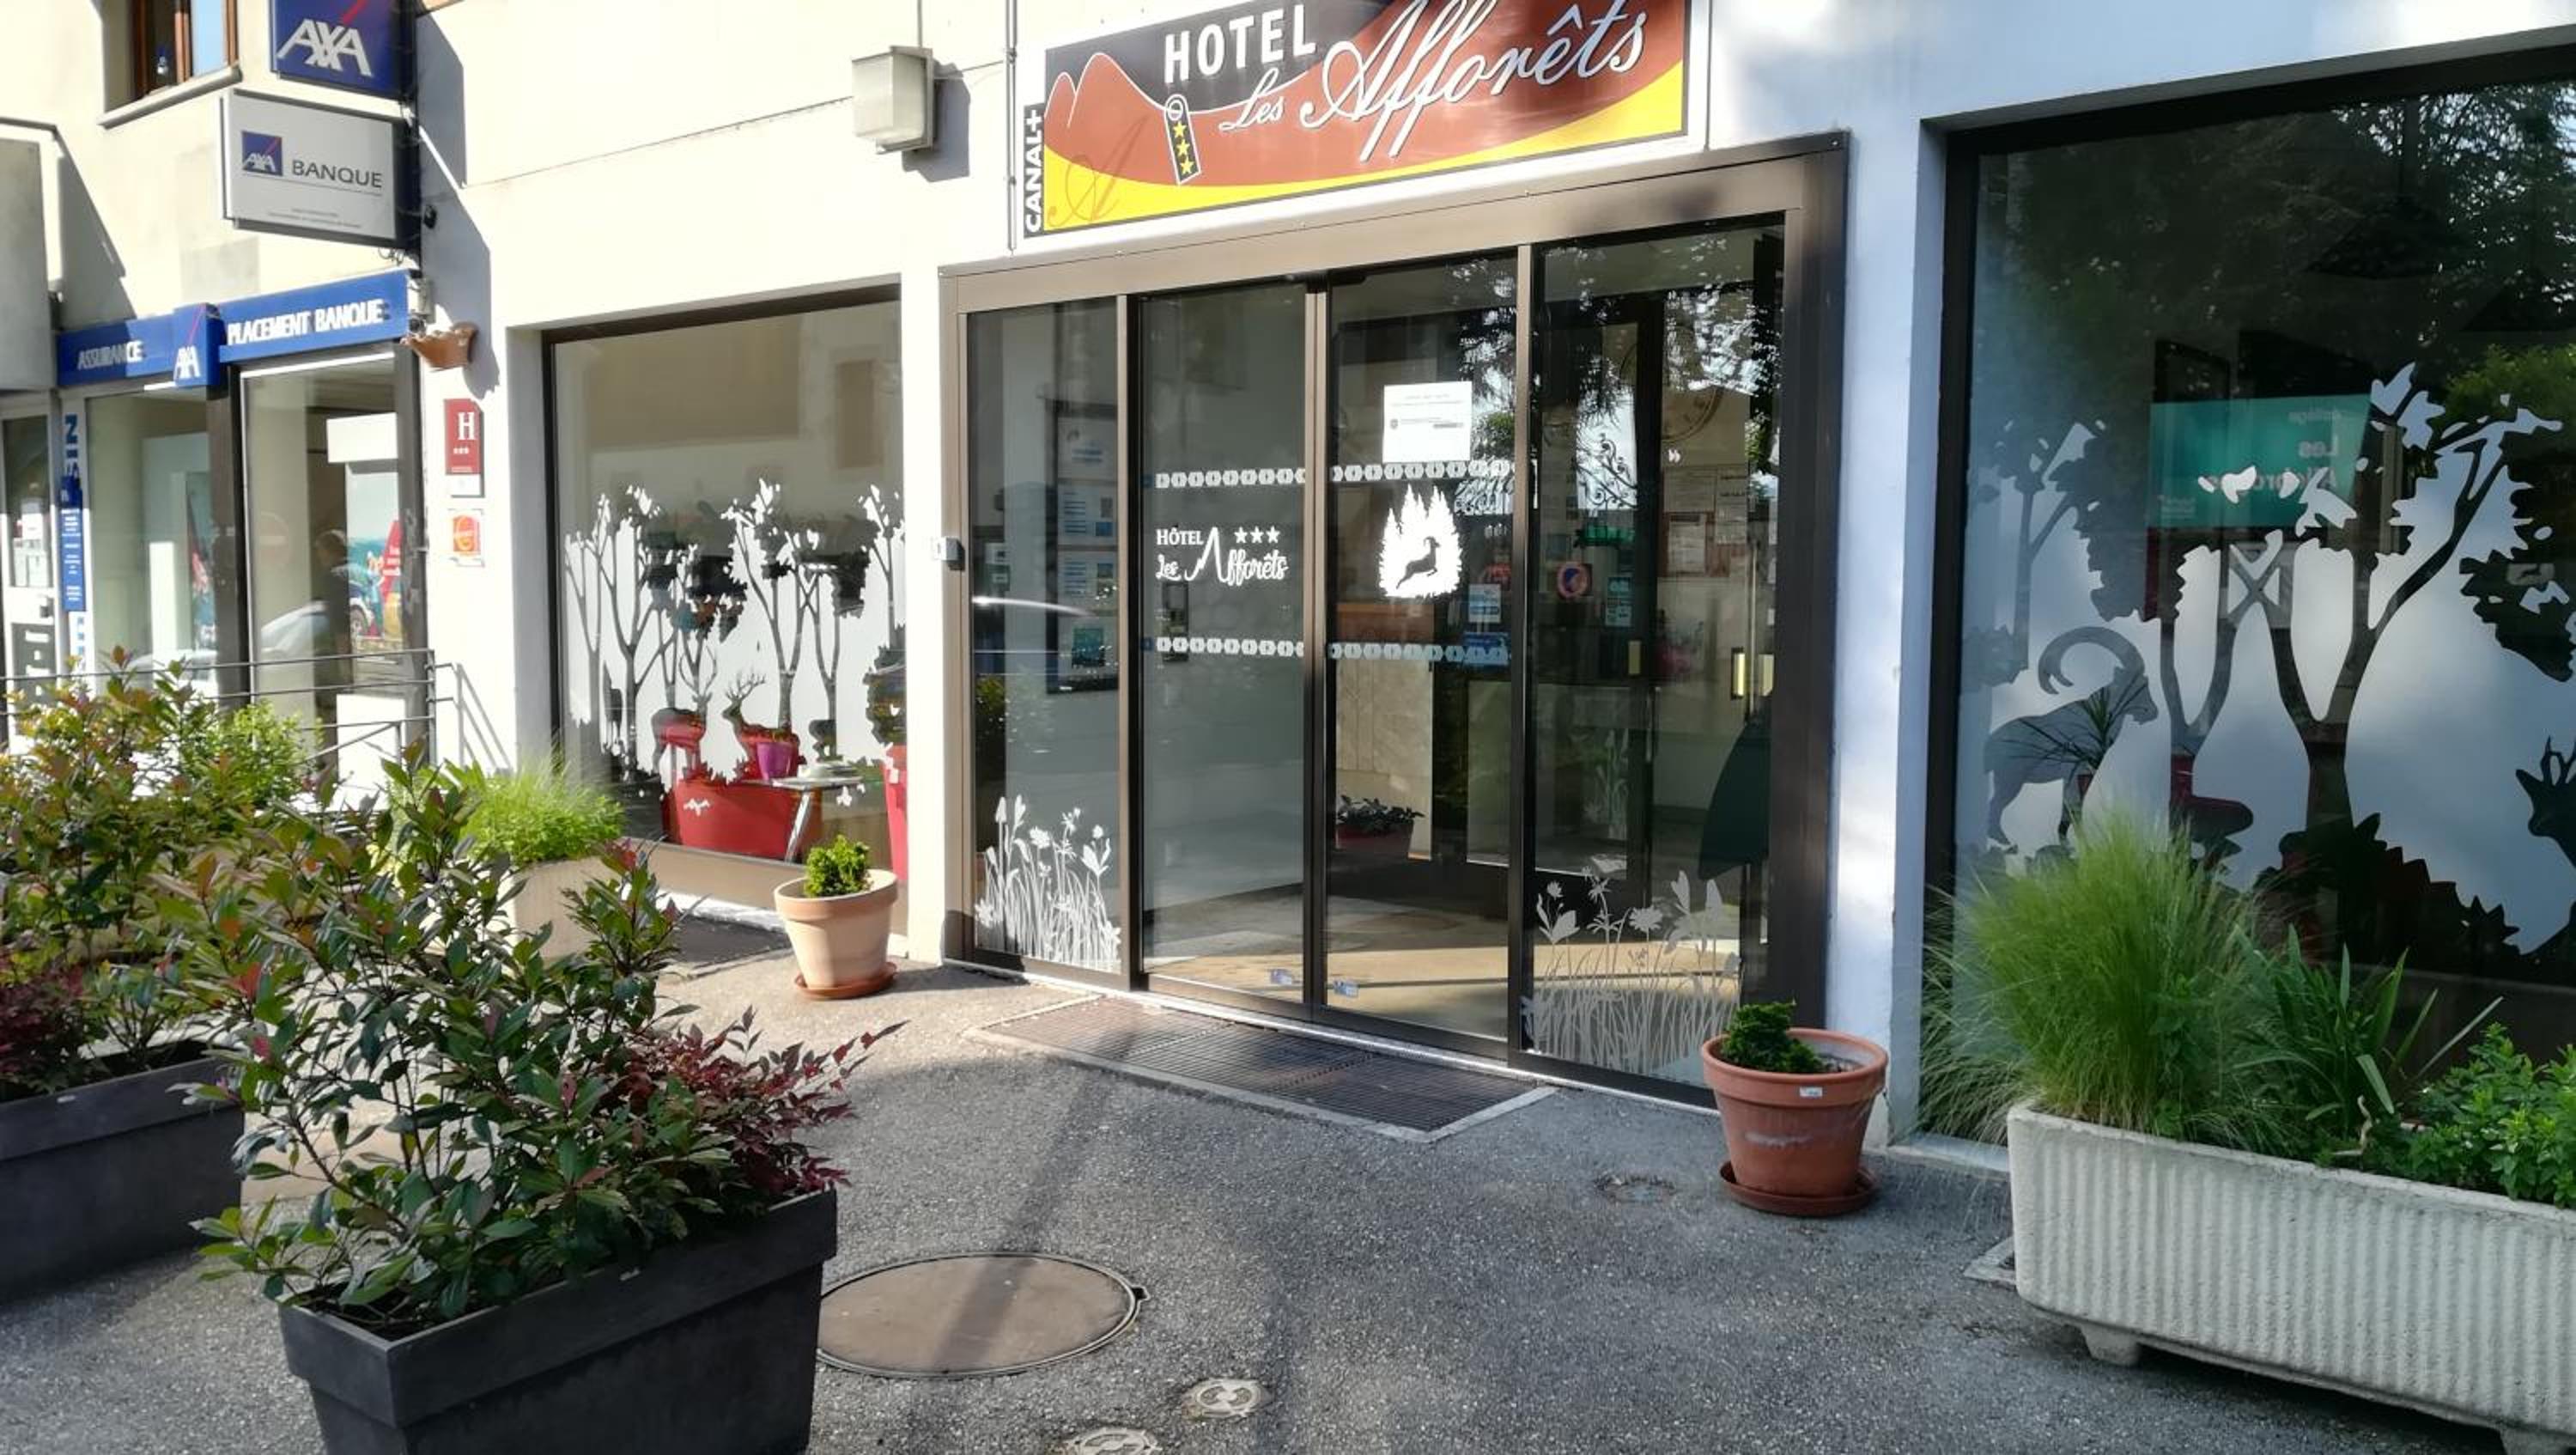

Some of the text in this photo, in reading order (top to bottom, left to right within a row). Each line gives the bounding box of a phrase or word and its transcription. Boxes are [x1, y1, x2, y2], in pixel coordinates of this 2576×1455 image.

[276, 19, 373, 77] AXA
[1163, 4, 1316, 84] HOTEL
[1218, 0, 1647, 163] Les Afforêts
[244, 152, 383, 189] AXA BANQUE
[1024, 109, 1045, 233] CANAL+
[228, 298, 386, 346] PLACEMENT BANQUE
[174, 345, 200, 379] AXA
[458, 411, 476, 441] H
[1155, 526, 1290, 587] Les Afforêts
[1156, 527, 1205, 546] HÔTEL
